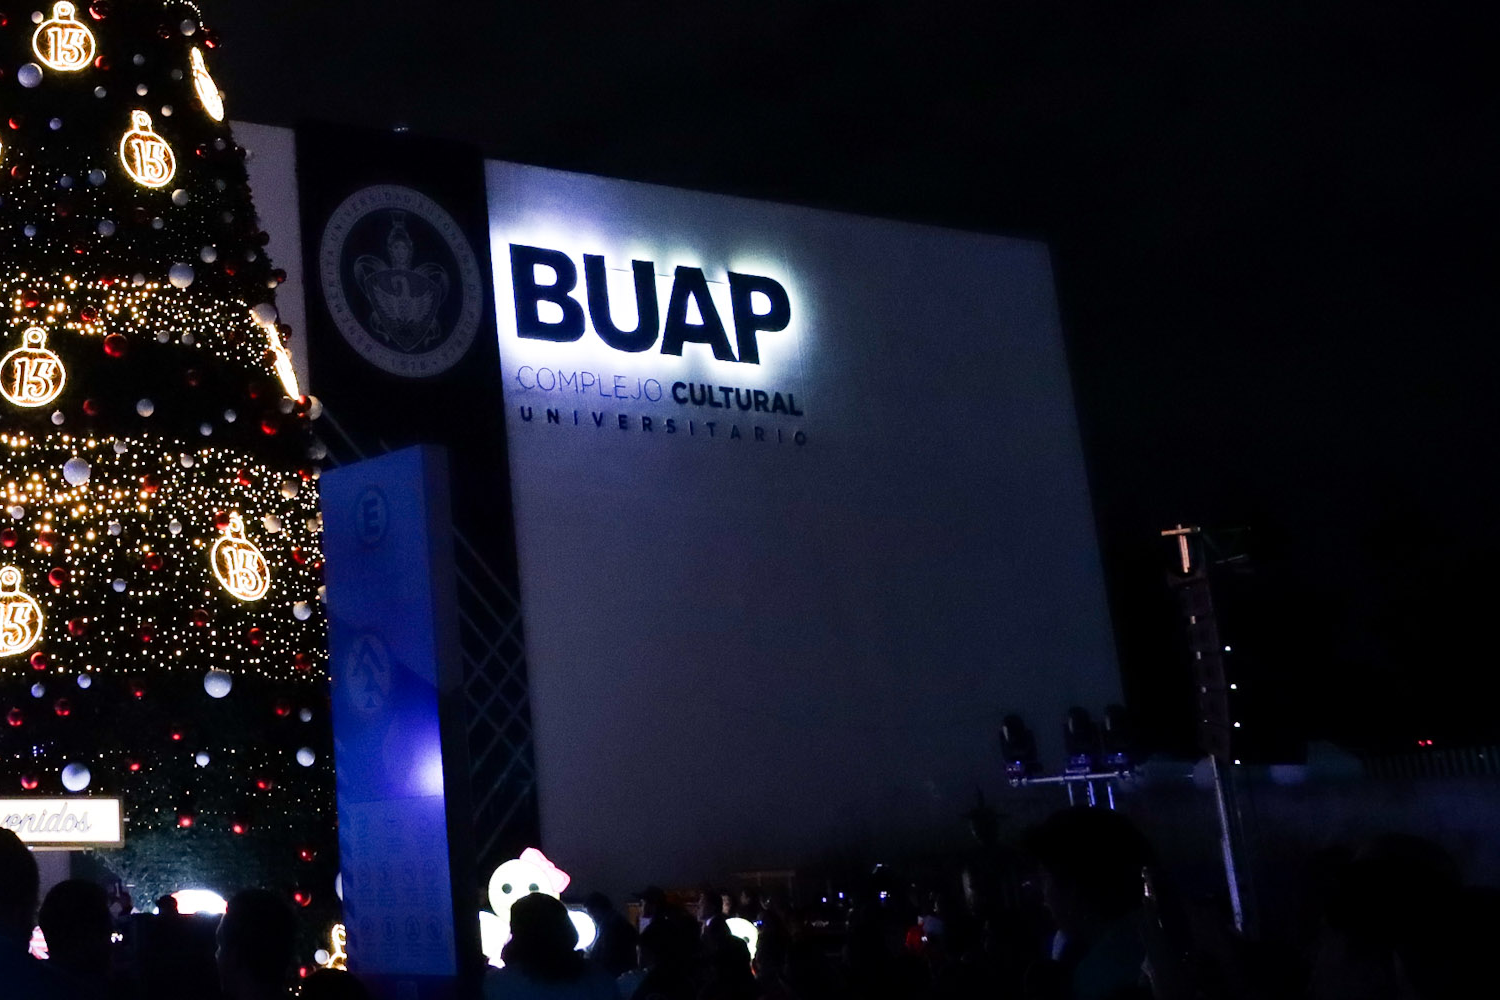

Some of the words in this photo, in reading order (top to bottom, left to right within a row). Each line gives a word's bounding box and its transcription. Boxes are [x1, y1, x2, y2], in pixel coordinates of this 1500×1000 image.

[46, 26, 87, 64] 15
[130, 139, 166, 181] 15
[509, 242, 791, 365] BUAP
[14, 357, 56, 397] 15
[516, 364, 664, 403] COMPLEJO
[671, 380, 804, 418] CULTURAL
[520, 405, 807, 447] UNIVERSITARIO
[224, 549, 260, 591] 15
